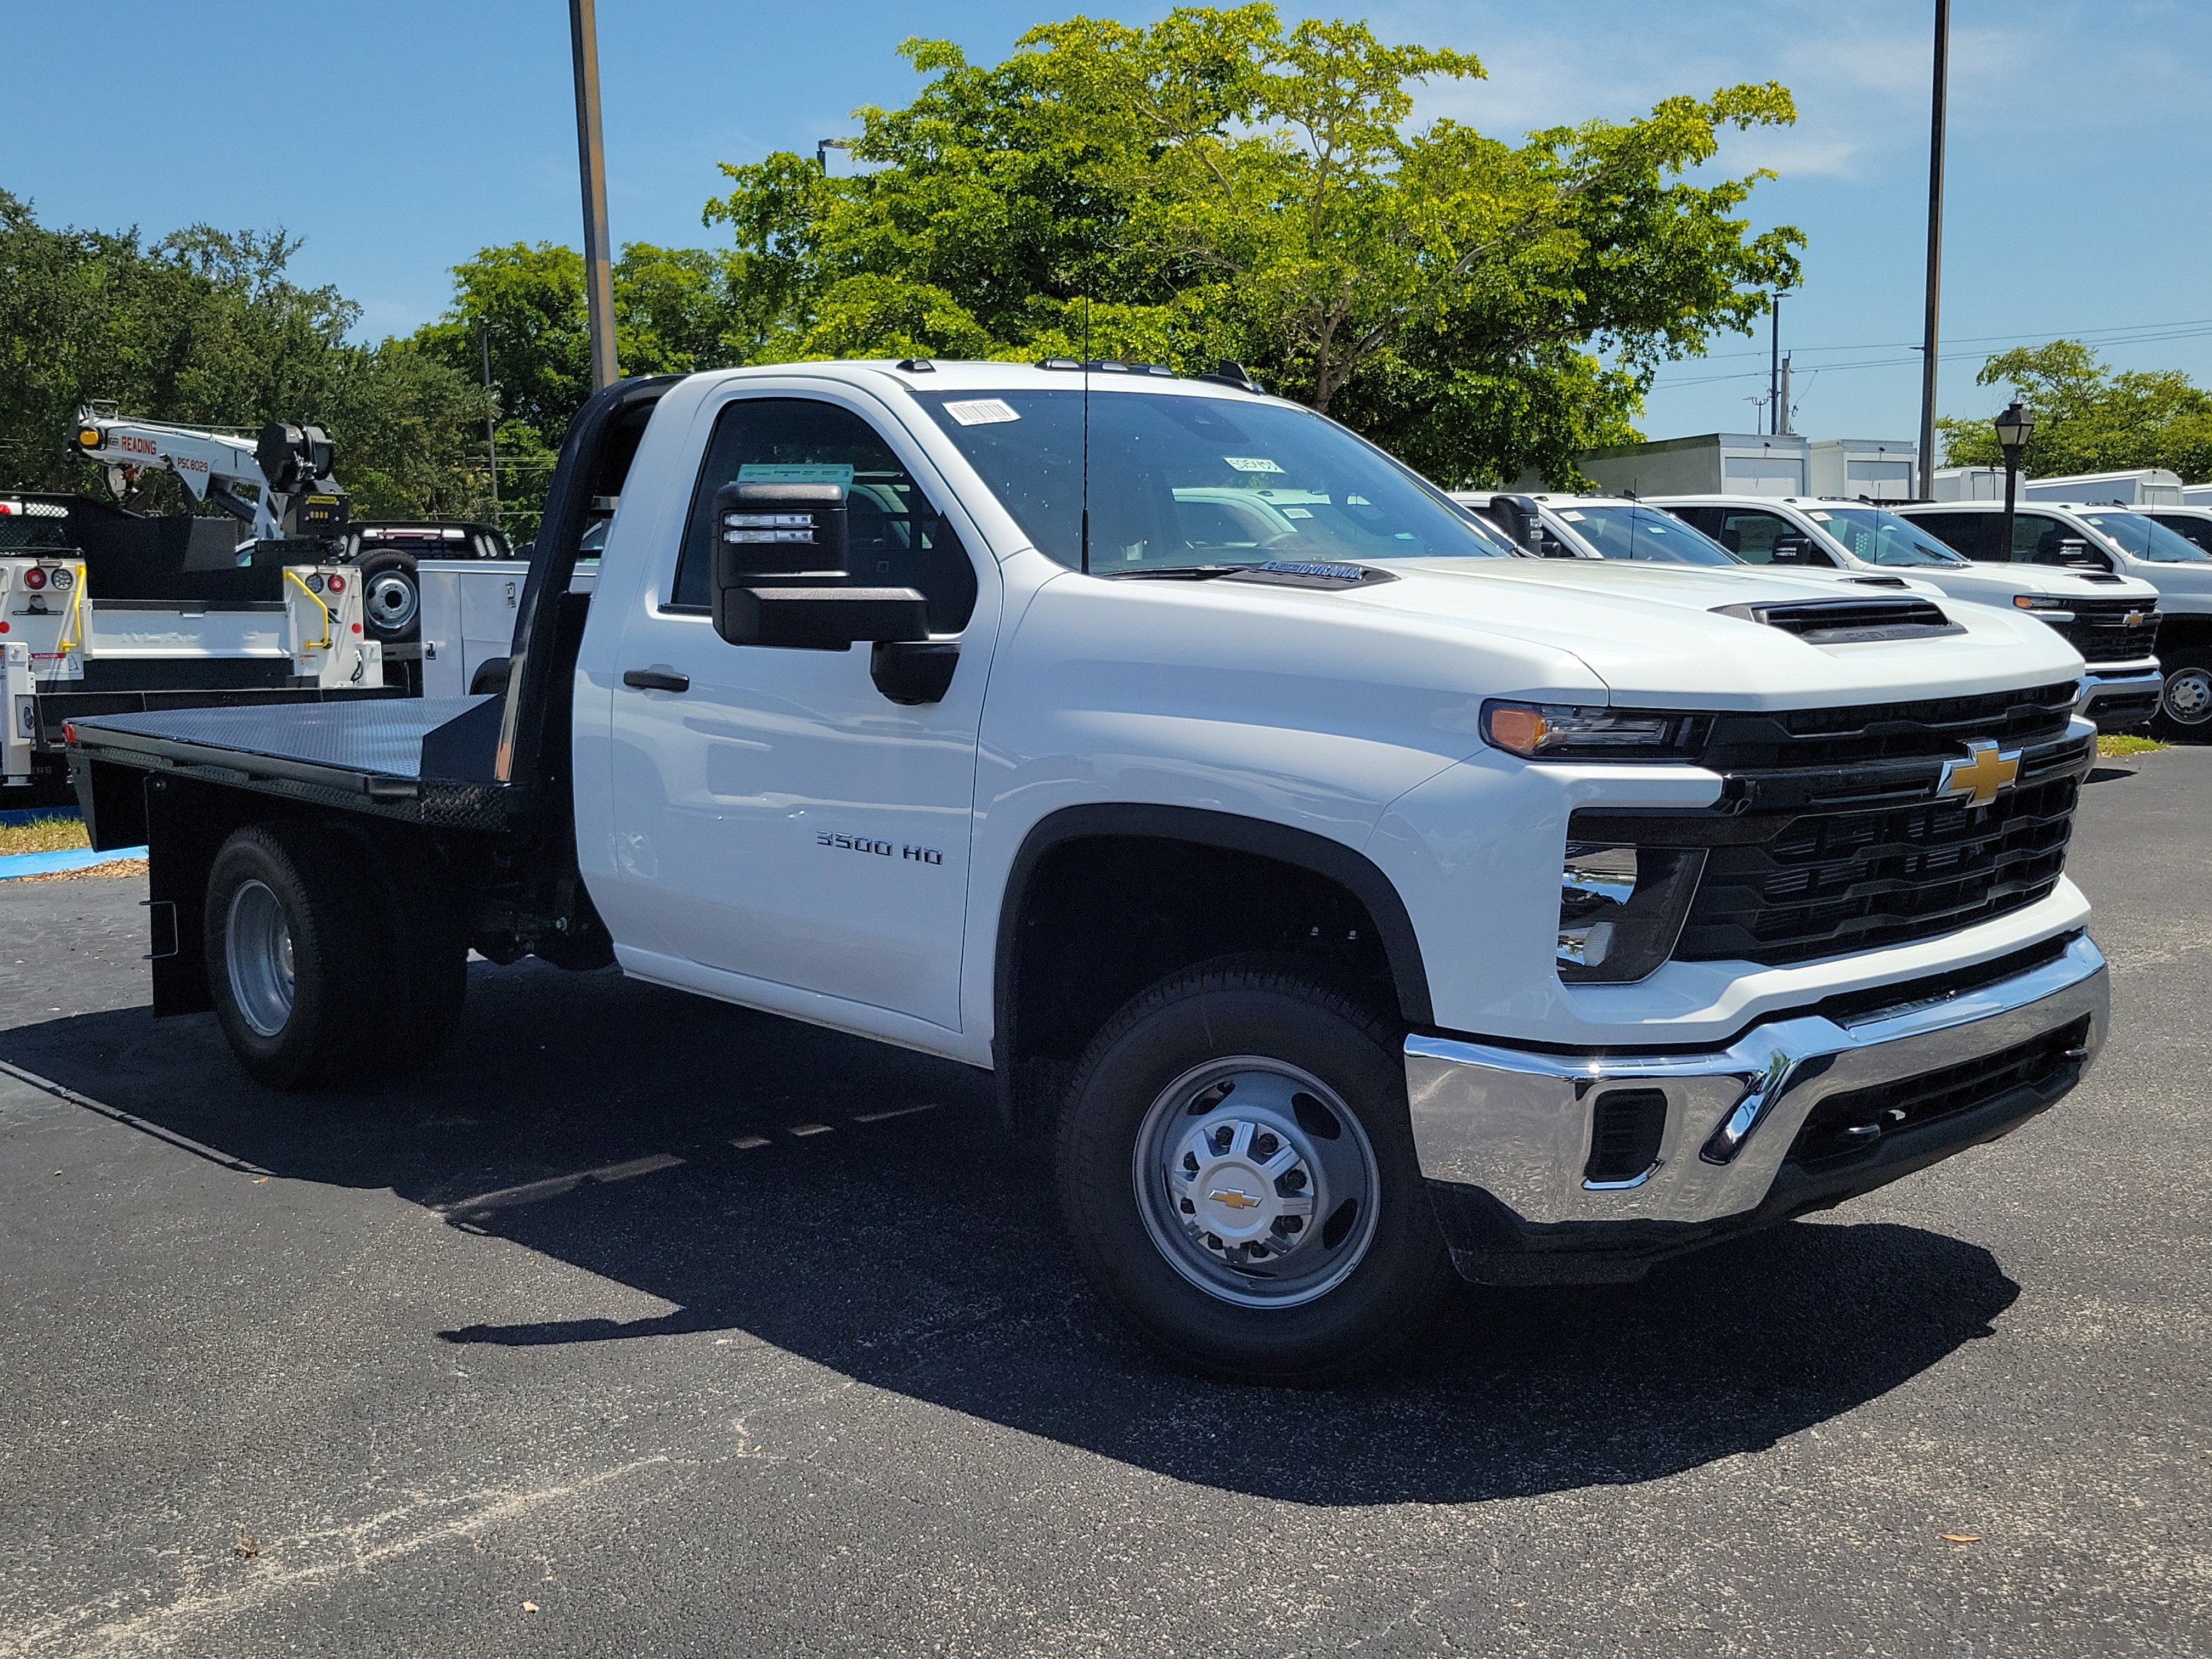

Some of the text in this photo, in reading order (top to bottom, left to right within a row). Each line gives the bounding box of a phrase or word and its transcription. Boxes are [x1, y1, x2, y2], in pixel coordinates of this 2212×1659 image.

[122, 436, 156, 455] READING
[817, 830, 943, 865] 3500 HD
